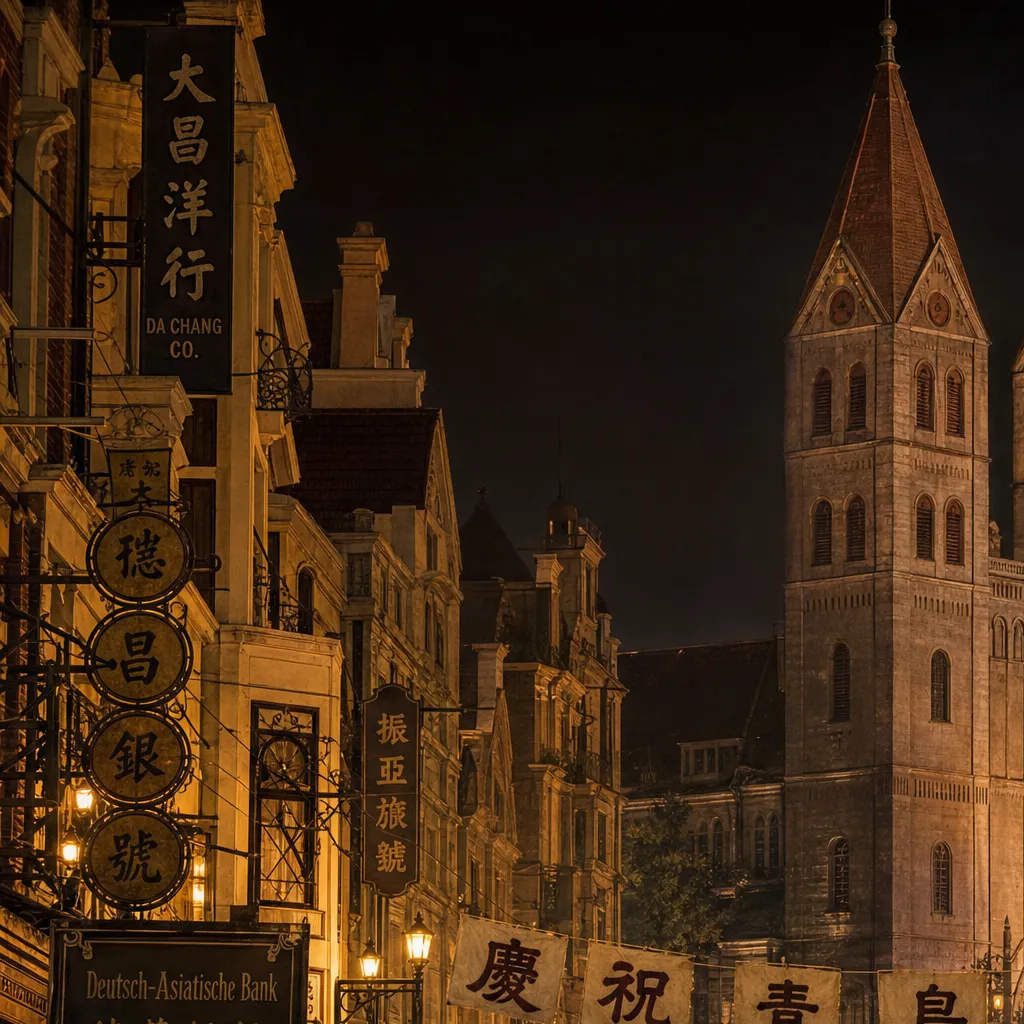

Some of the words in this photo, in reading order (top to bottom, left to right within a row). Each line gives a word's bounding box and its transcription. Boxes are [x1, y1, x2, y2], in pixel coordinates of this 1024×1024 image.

[161, 53, 216, 301] 大昌洋行
[146, 317, 166, 335] DA
[170, 317, 222, 335] CHANG
[170, 341, 199, 359] CO.
[86, 970, 236, 1001] Deutsch-Asiatische
[240, 972, 278, 1002] Bank
